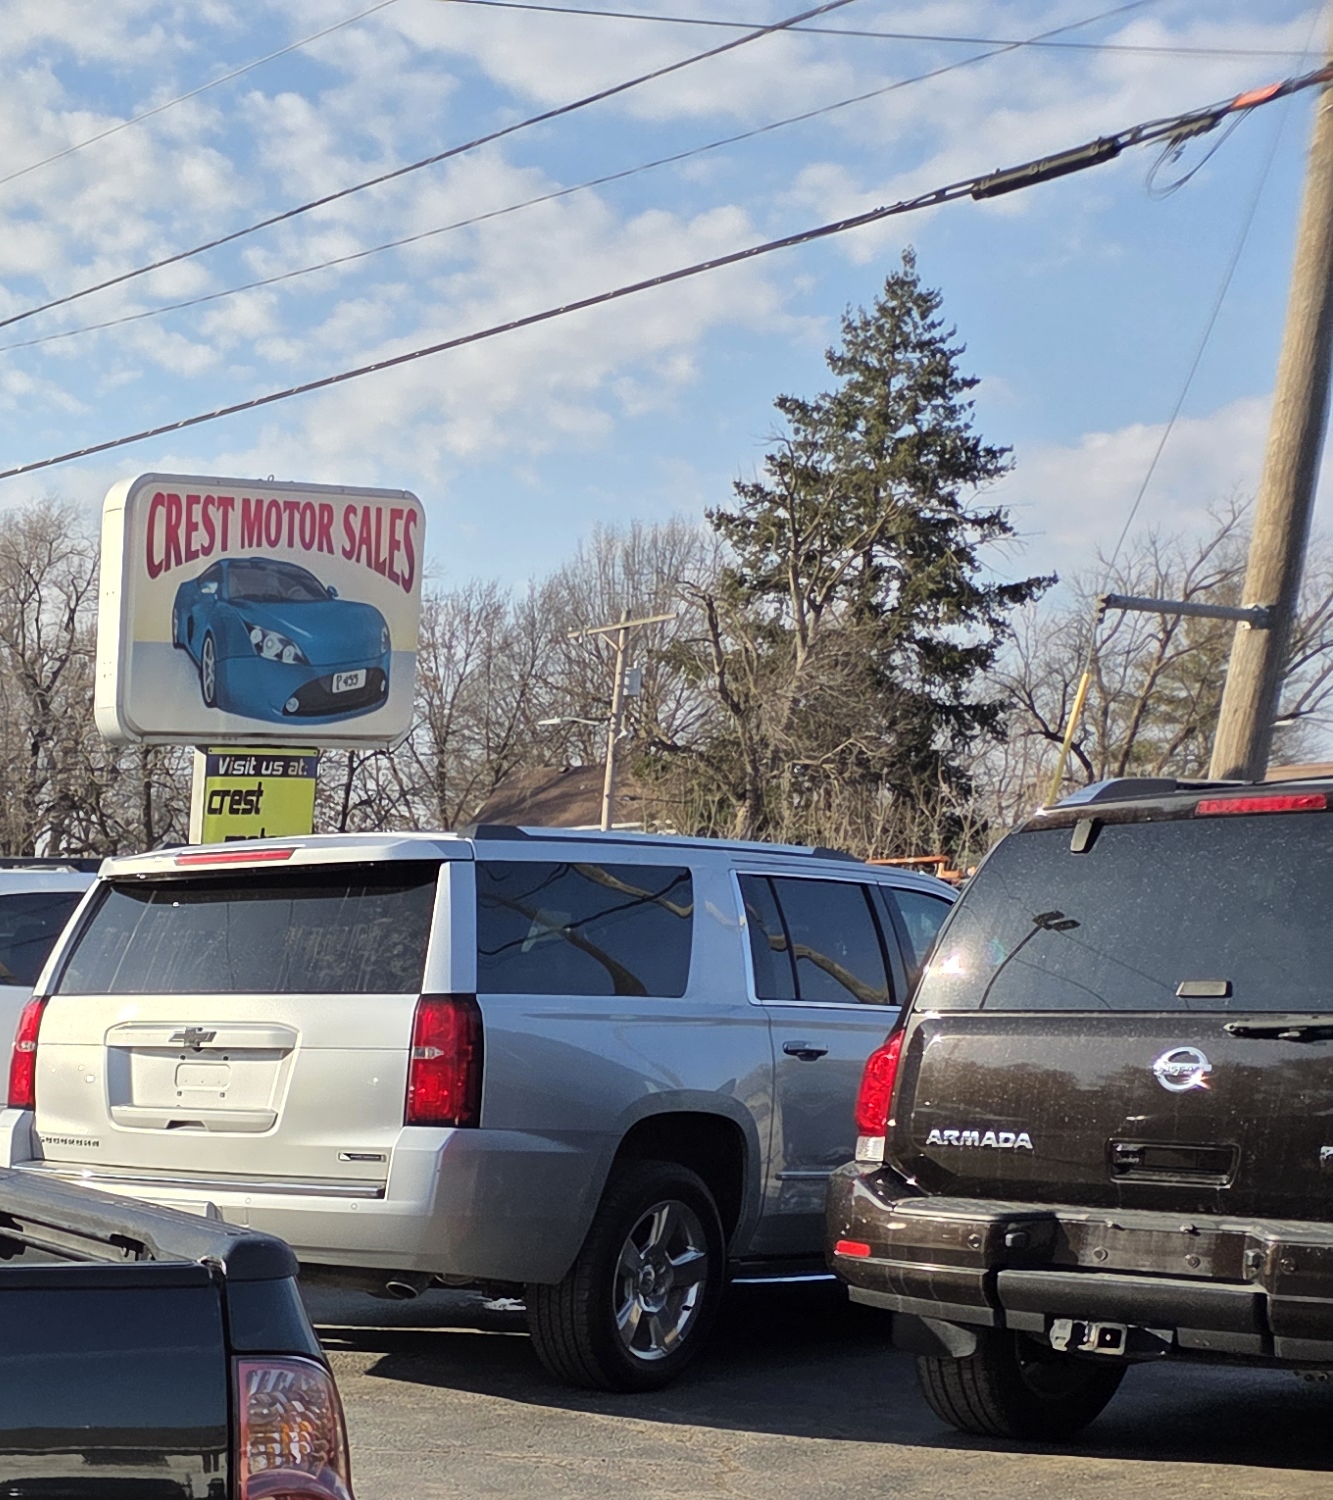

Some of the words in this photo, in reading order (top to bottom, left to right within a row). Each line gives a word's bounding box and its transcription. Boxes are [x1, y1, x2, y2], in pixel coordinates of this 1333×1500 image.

[146, 492, 234, 580] CREST
[241, 498, 334, 555] MOTOR
[342, 504, 417, 593] SALES
[218, 757, 257, 775] Visit
[261, 761, 284, 775] us
[287, 758, 308, 775] at:
[207, 781, 264, 815] crest
[926, 1129, 1033, 1149] ARMADA
